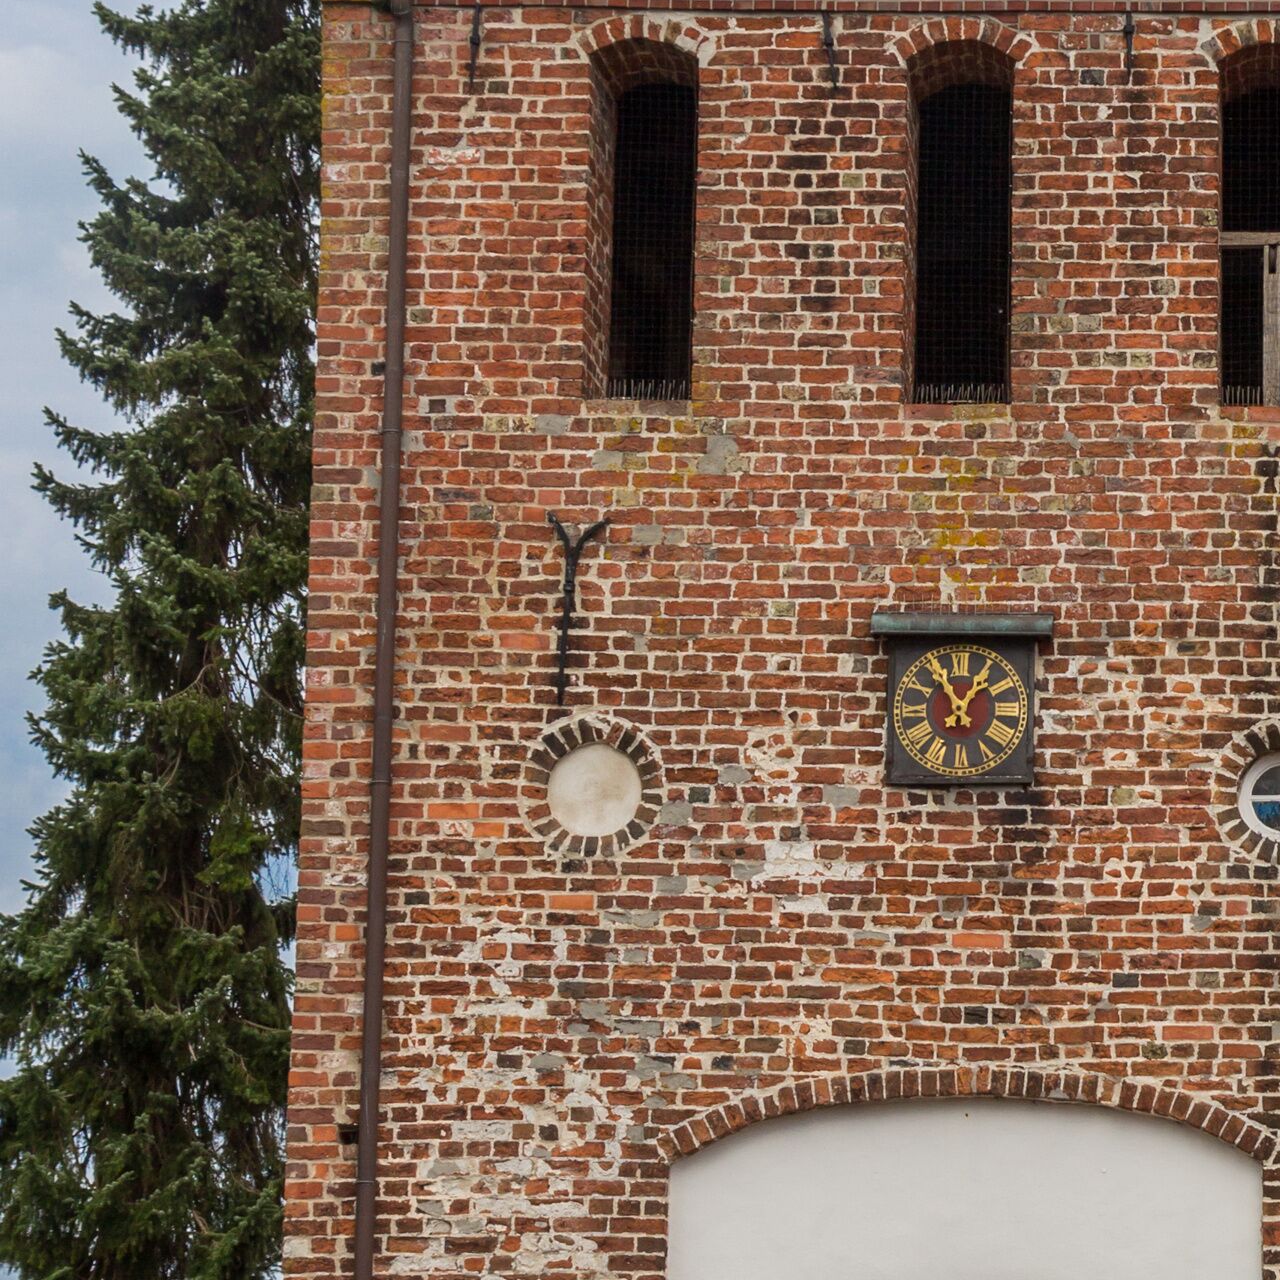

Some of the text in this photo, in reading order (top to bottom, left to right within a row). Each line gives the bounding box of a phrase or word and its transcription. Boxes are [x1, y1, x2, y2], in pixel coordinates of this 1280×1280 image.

[949, 652, 970, 677] XII
[907, 676, 934, 698] X
[988, 676, 1014, 697] II
[901, 702, 927, 718] IX
[995, 701, 1019, 717] III
[905, 720, 933, 750] VIII
[954, 744, 969, 768] VI
[977, 739, 996, 762] V
